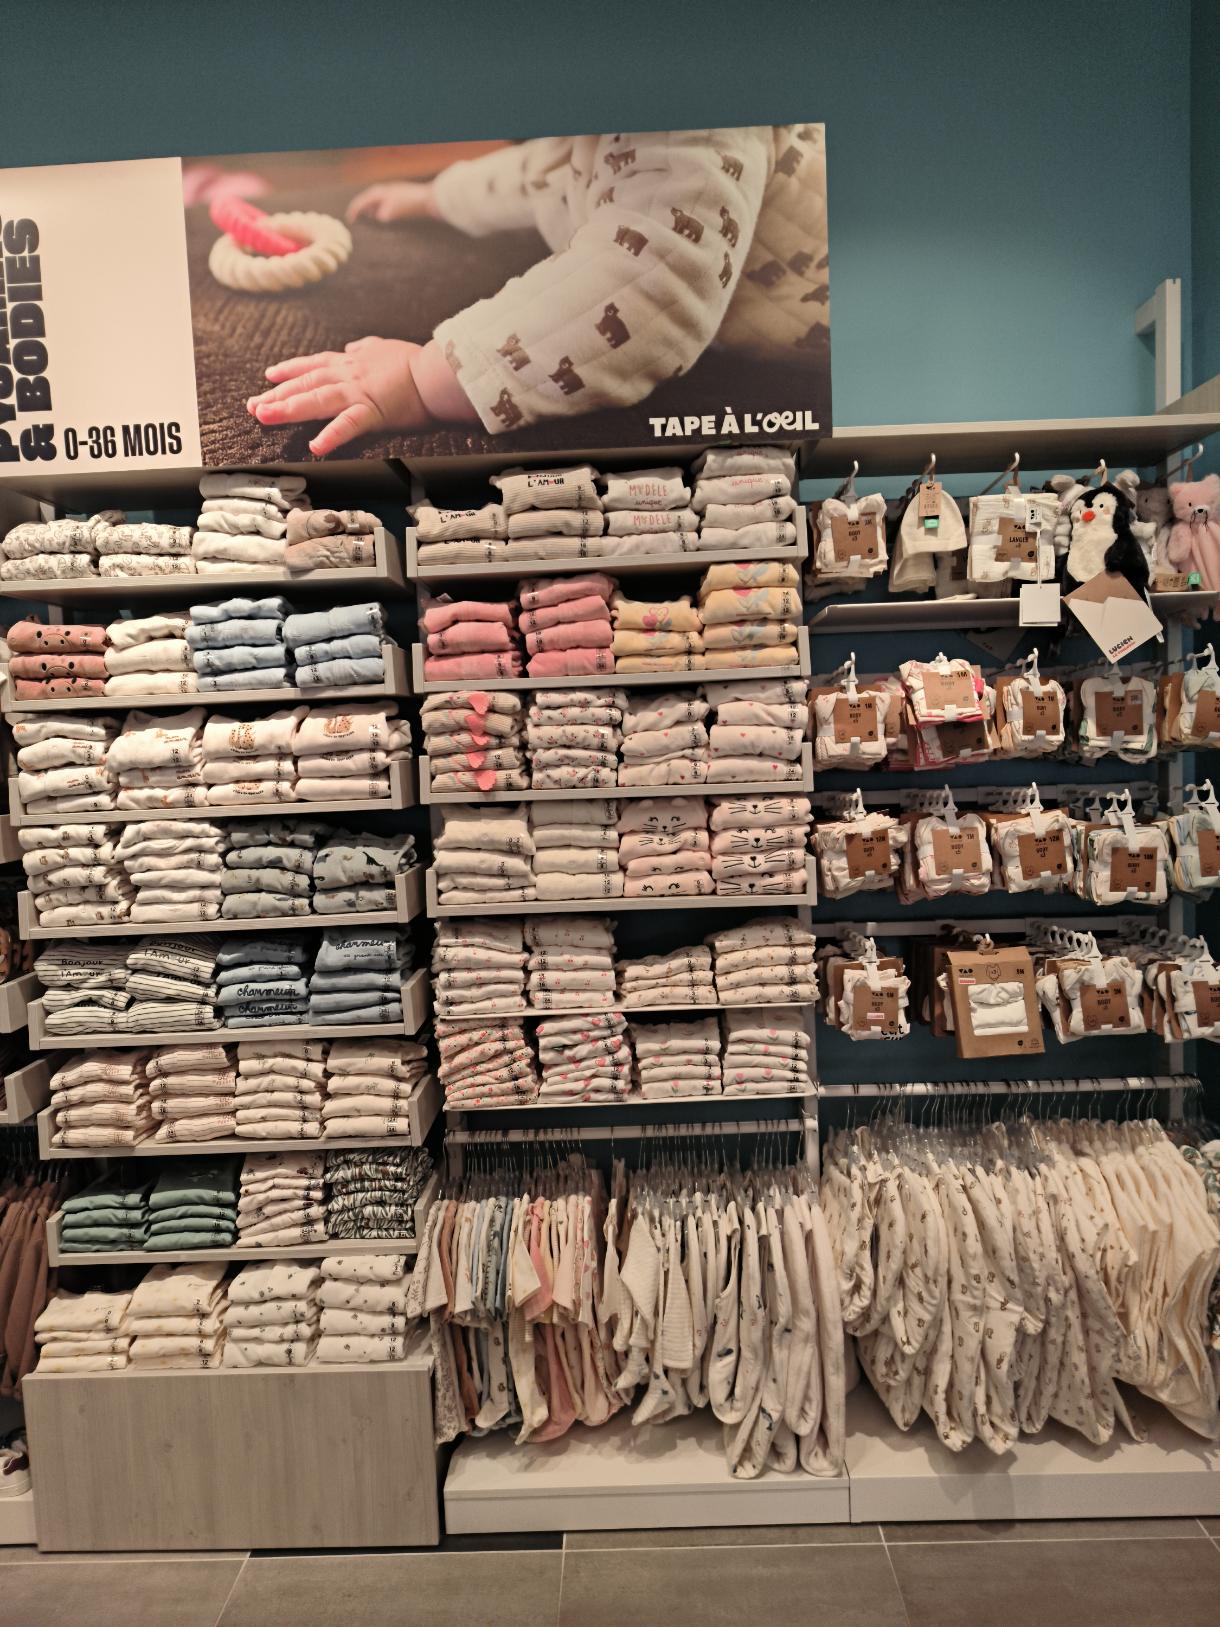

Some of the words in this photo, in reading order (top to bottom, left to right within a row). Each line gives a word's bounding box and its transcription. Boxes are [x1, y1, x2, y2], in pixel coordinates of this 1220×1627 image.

[3, 218, 52, 412] BODIES
[649, 415, 716, 437] TAPE
[720, 406, 740, 435] À
[20, 423, 57, 461] &
[63, 426, 117, 460] 0-36
[121, 422, 182, 457] MOIS
